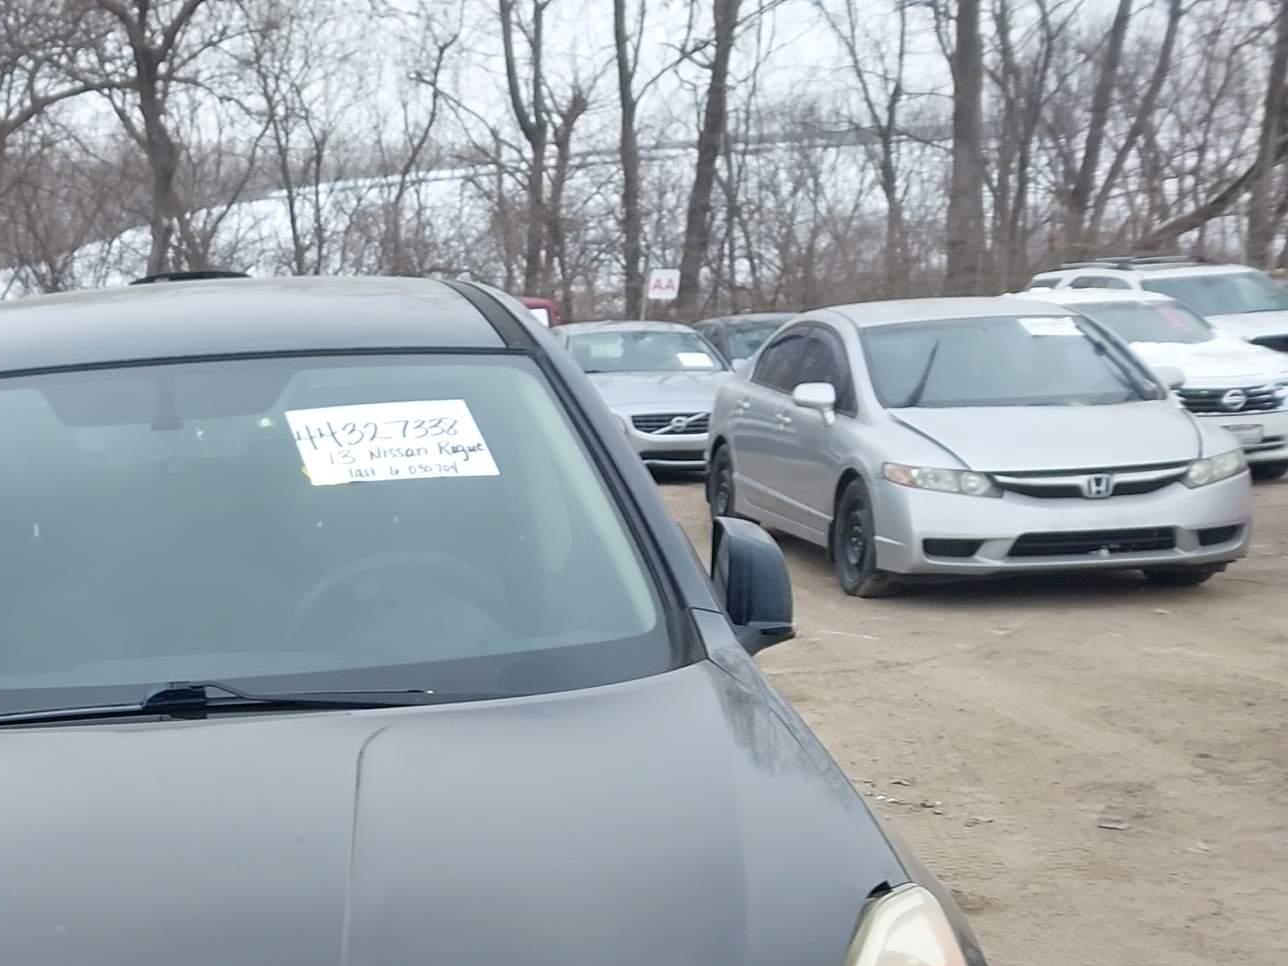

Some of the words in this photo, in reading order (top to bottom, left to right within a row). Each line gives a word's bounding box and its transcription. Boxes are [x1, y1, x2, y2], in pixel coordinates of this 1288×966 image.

[652, 278, 675, 291] AA
[295, 417, 458, 450] 44327338
[328, 448, 357, 465] 13
[370, 445, 429, 461] Nissan
[438, 440, 485, 462] Rogue
[349, 466, 376, 479] last
